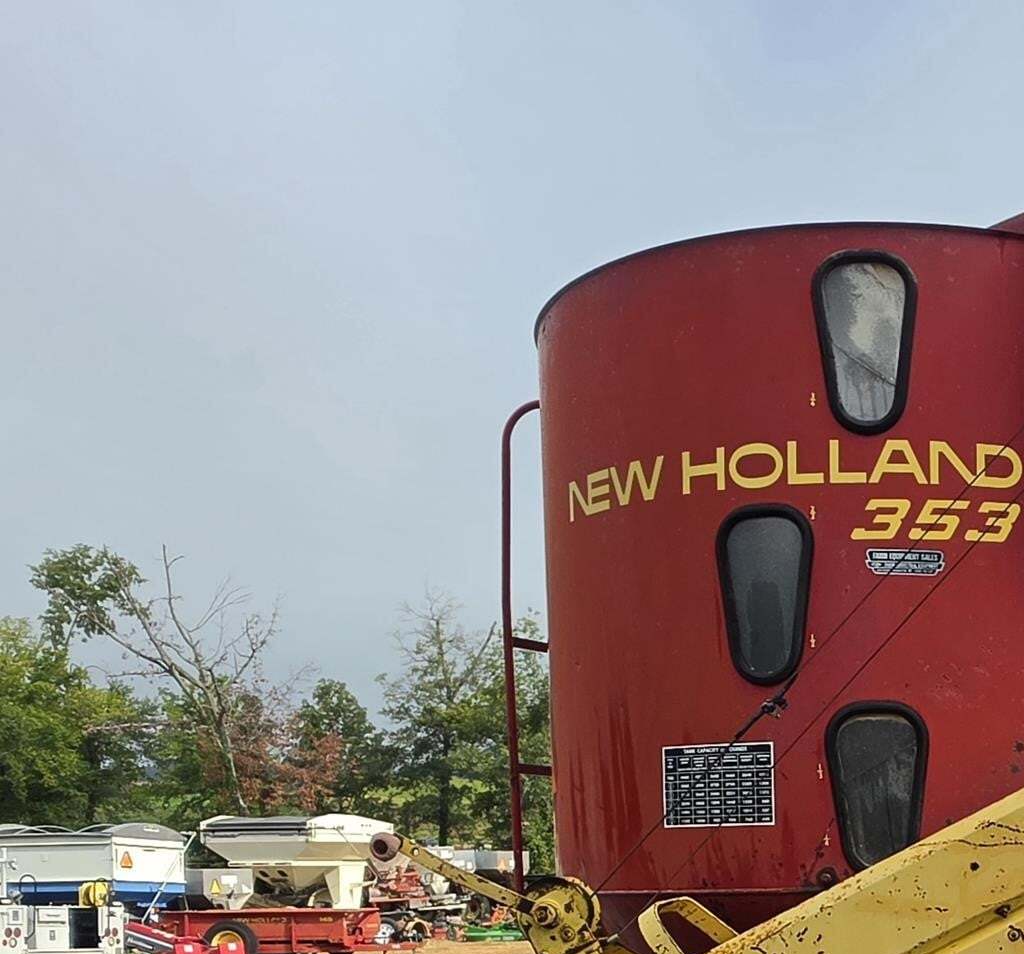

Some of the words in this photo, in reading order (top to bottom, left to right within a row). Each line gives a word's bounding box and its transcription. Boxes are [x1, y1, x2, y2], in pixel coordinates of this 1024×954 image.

[568, 455, 664, 523] NEW
[681, 439, 1023, 495] HOLLAND
[850, 499, 1021, 543] 353
